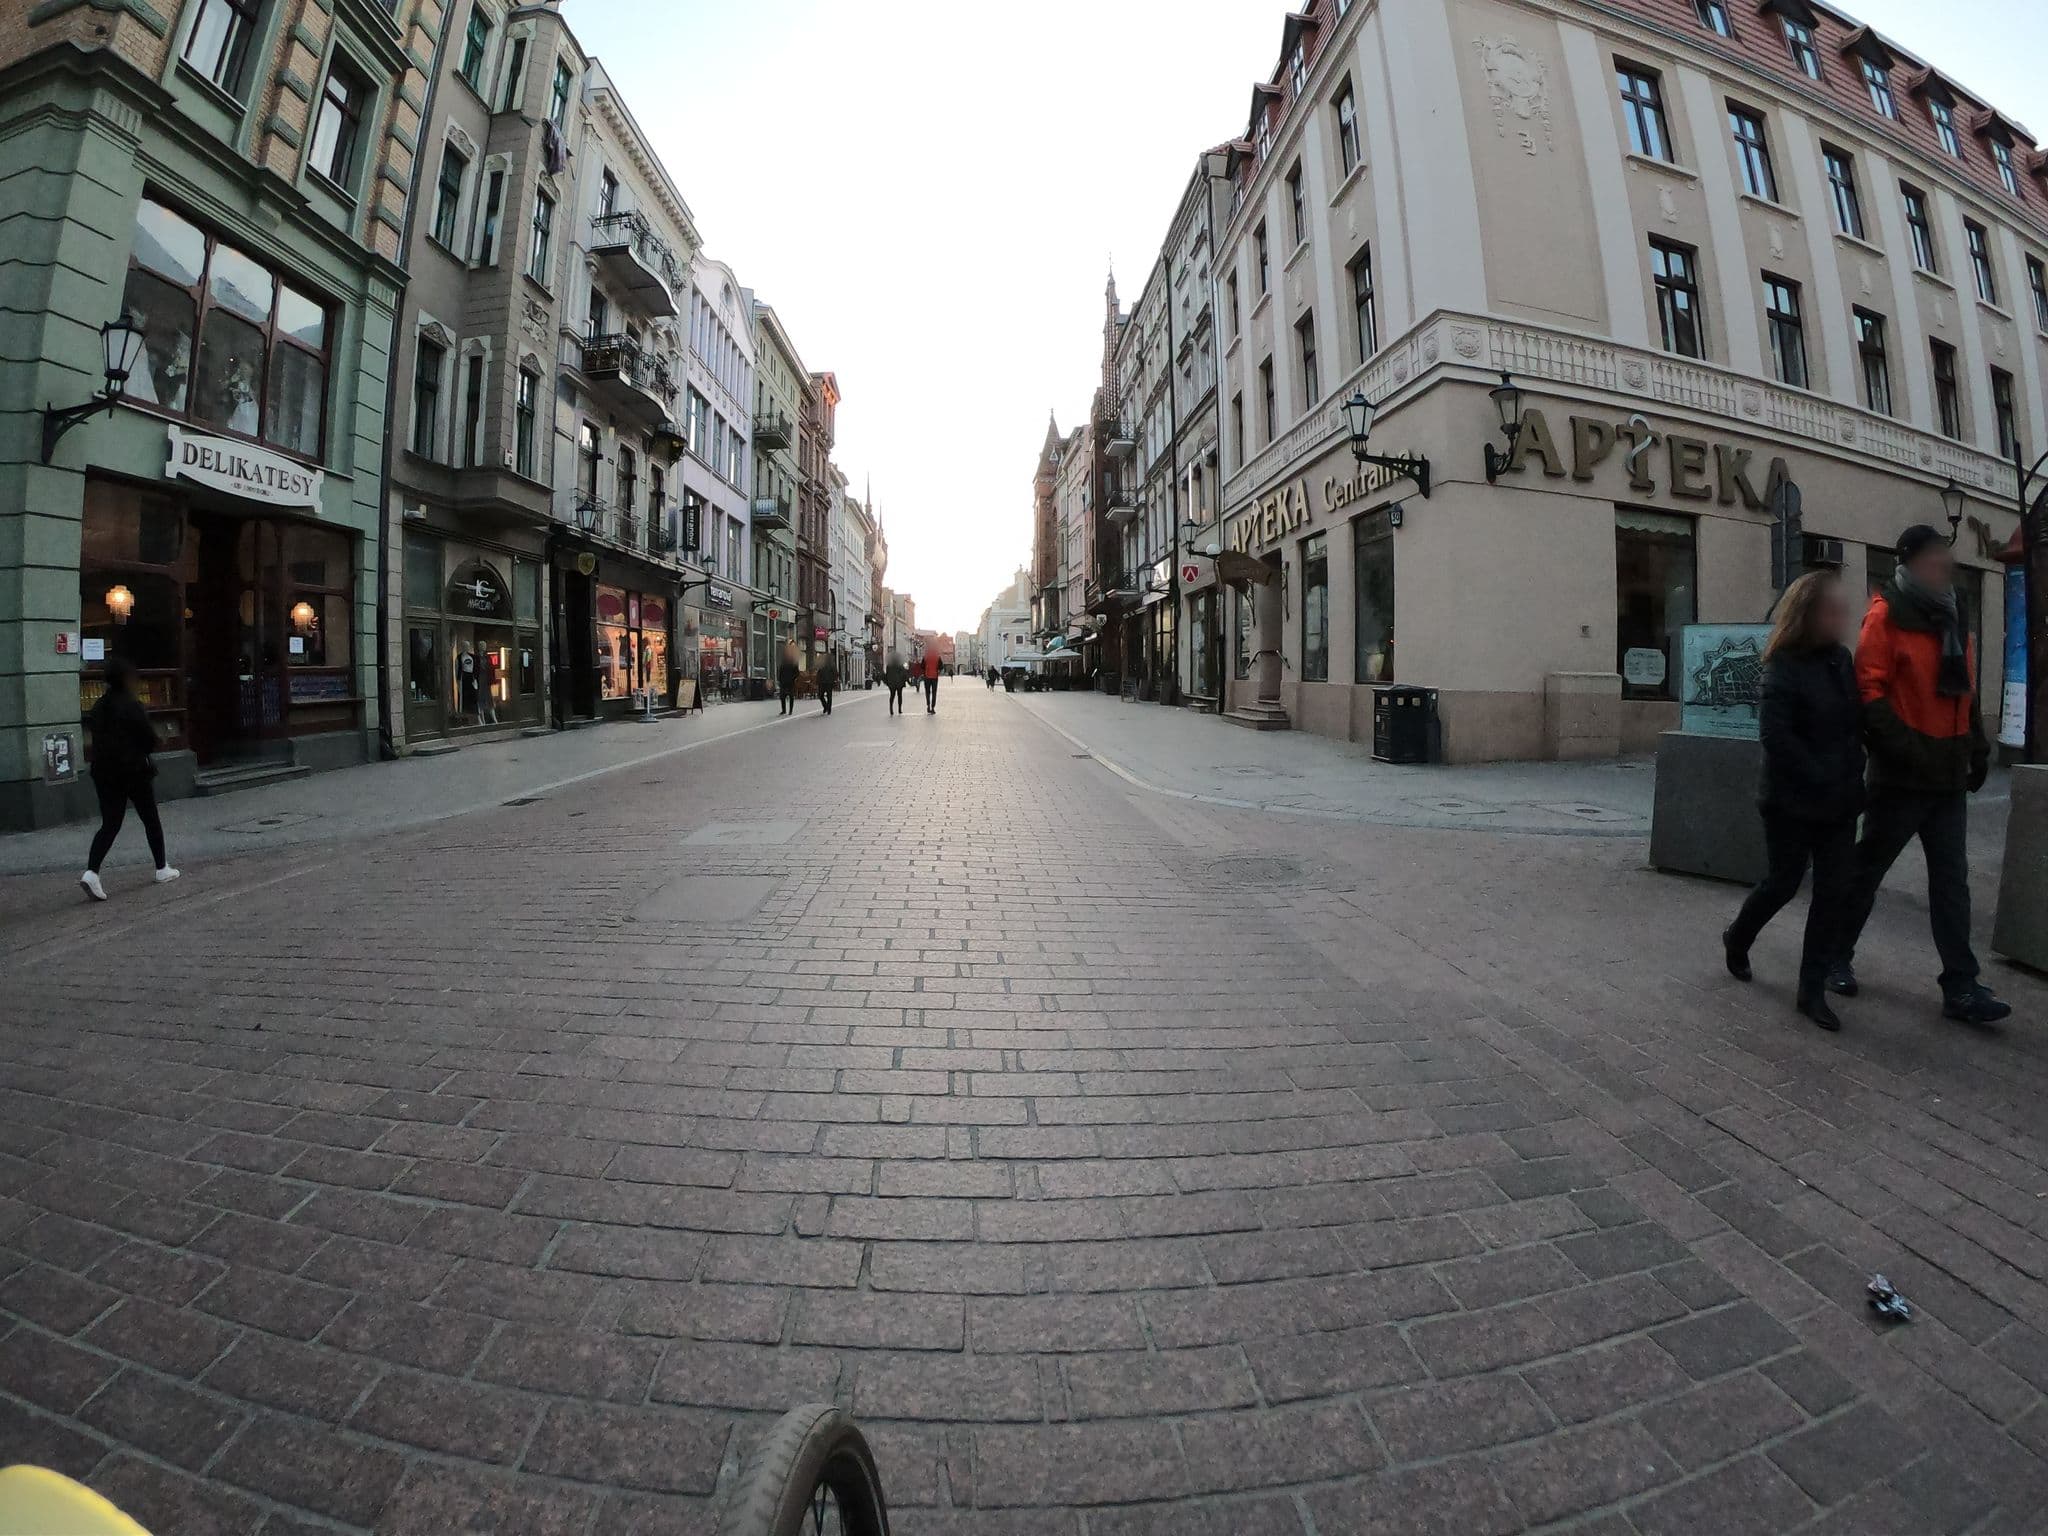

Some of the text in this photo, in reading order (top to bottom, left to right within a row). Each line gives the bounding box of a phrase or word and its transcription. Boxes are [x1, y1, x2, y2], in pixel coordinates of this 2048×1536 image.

[182, 441, 314, 497] DELIKATESY
[1511, 408, 1795, 513] APTEKA
[1231, 478, 1312, 555] APTEKA
